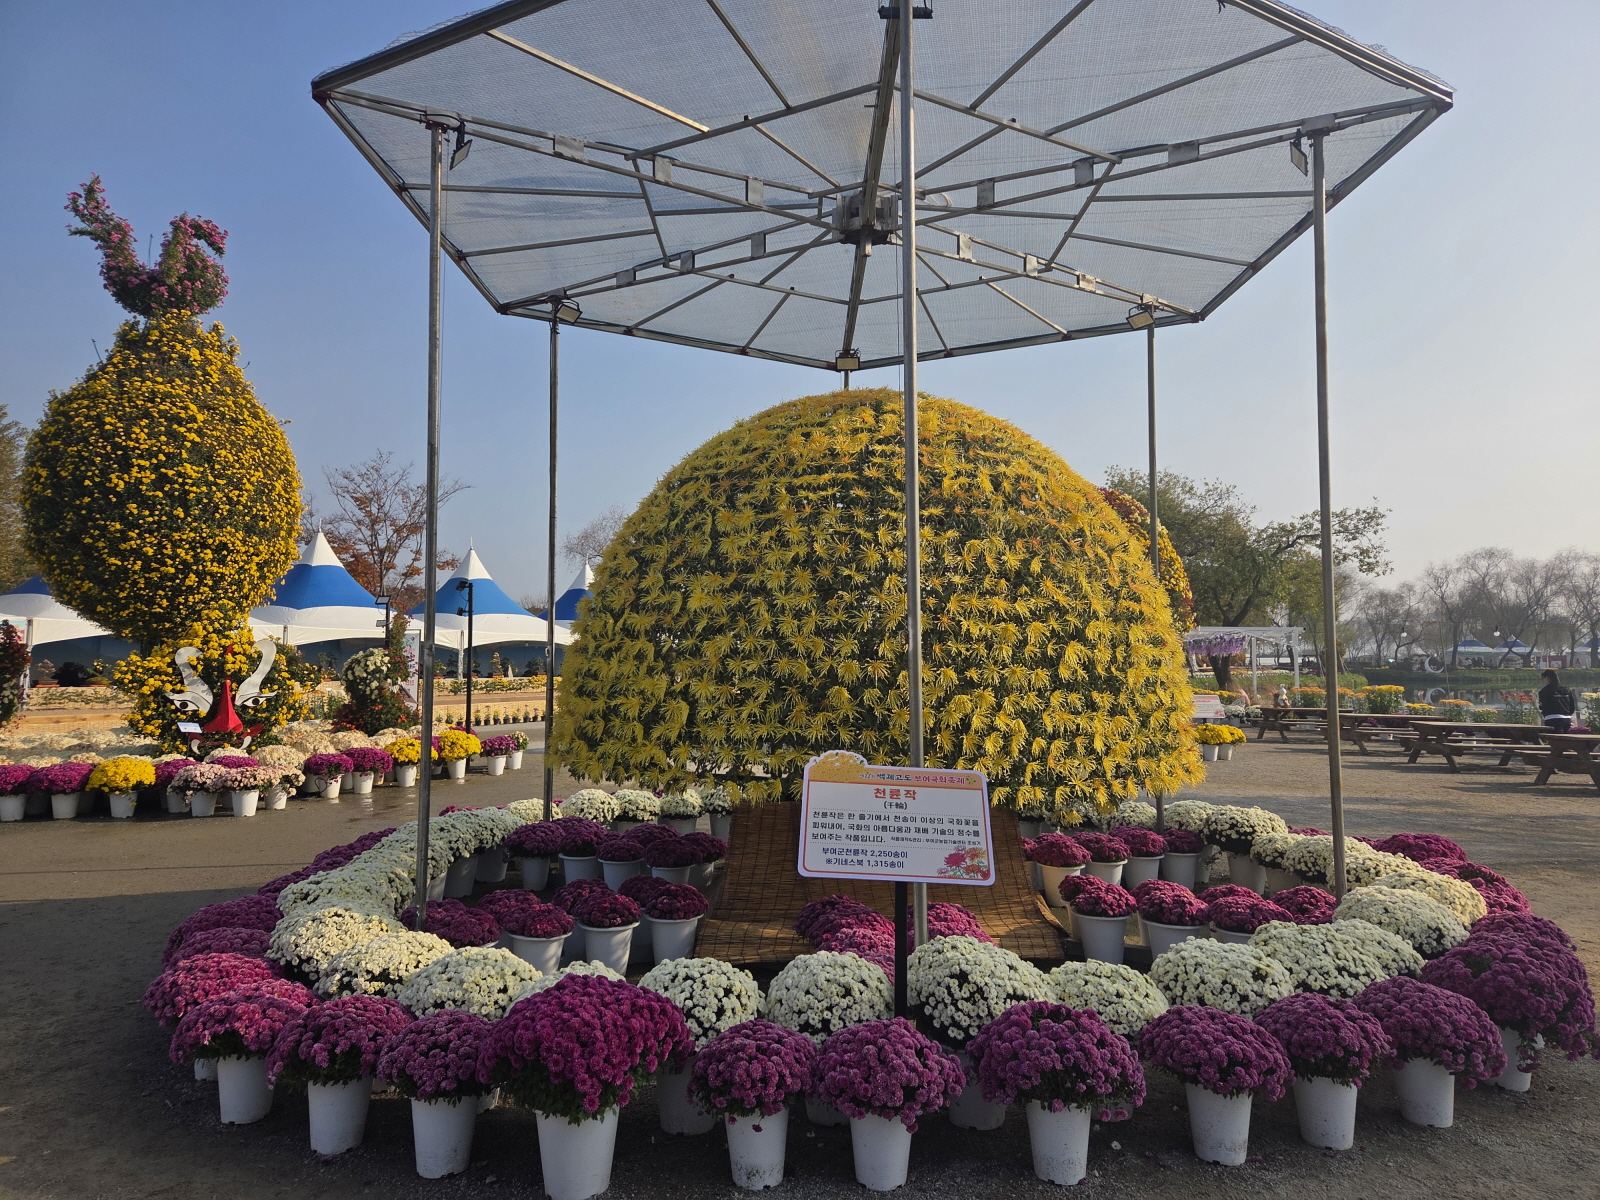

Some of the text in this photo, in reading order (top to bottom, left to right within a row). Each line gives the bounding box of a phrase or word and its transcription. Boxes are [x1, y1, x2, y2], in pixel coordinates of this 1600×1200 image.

[874, 788, 917, 800] 천륜작
[884, 801, 908, 810] (千輪)
[813, 812, 844, 820] 천륜작은
[947, 818, 979, 826] 국화꽃을
[812, 822, 845, 831] 피워내어,
[873, 825, 911, 834] 아름다움과
[812, 833, 886, 843] 보여주는 작품입니다.
[822, 847, 908, 859] 부여군천륜작 2,250송이
[867, 860, 904, 869] 1,315송이
